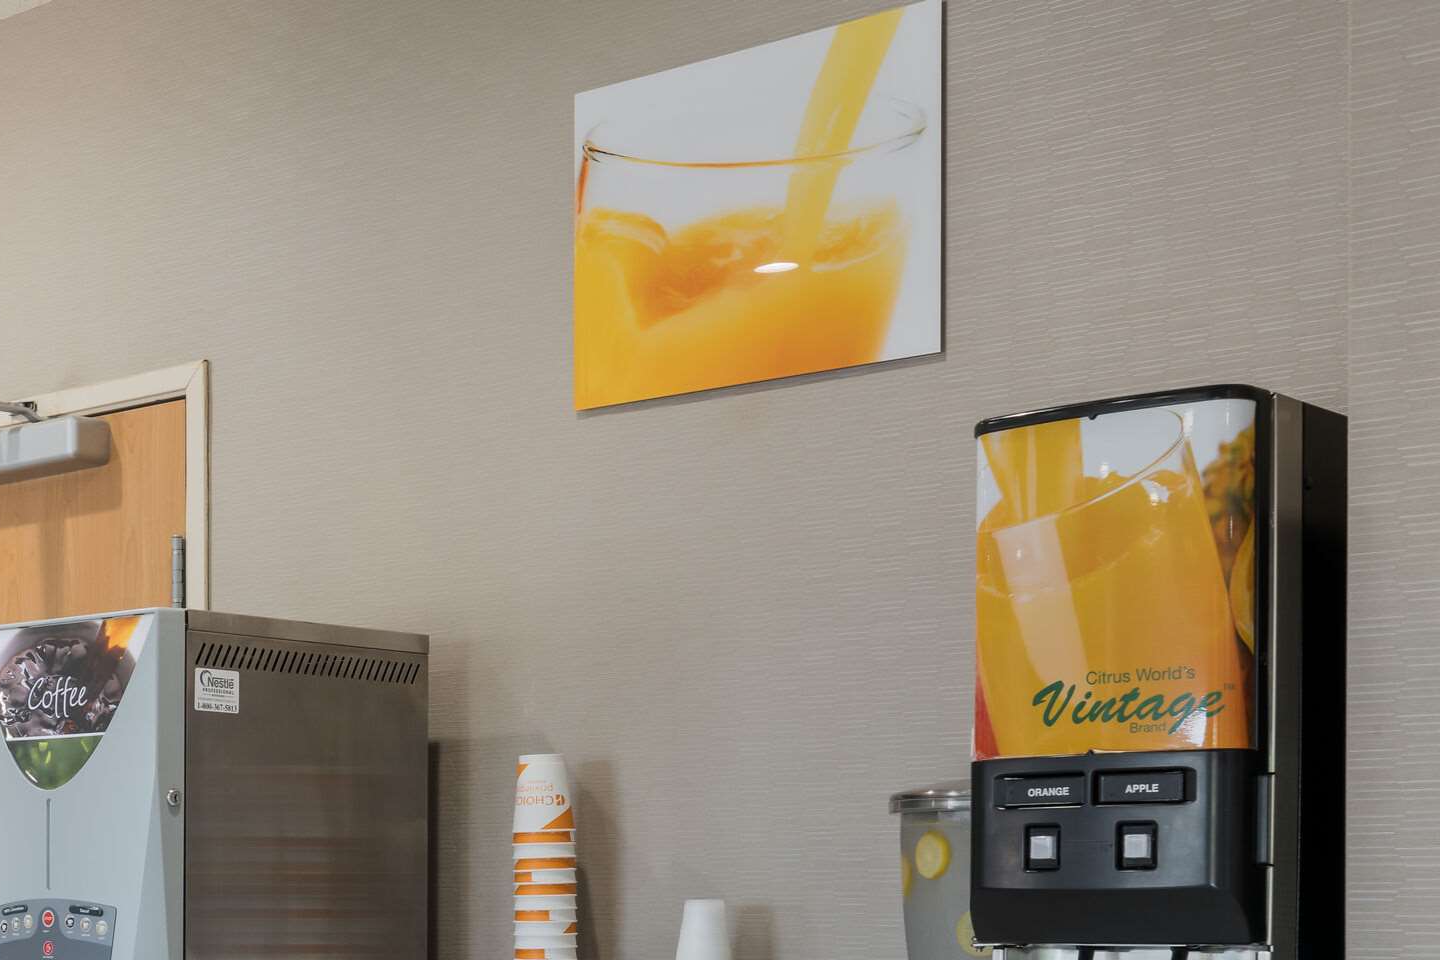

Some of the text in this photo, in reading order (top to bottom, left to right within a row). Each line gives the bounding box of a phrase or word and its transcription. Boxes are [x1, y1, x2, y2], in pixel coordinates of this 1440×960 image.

[1085, 666, 1196, 686] Citrus World's
[28, 676, 88, 719] Coffee
[1032, 680, 1226, 736] Vintage
[1128, 722, 1167, 734] Brand
[1027, 786, 1070, 797] ORANGE
[1124, 783, 1160, 794] APPLE
